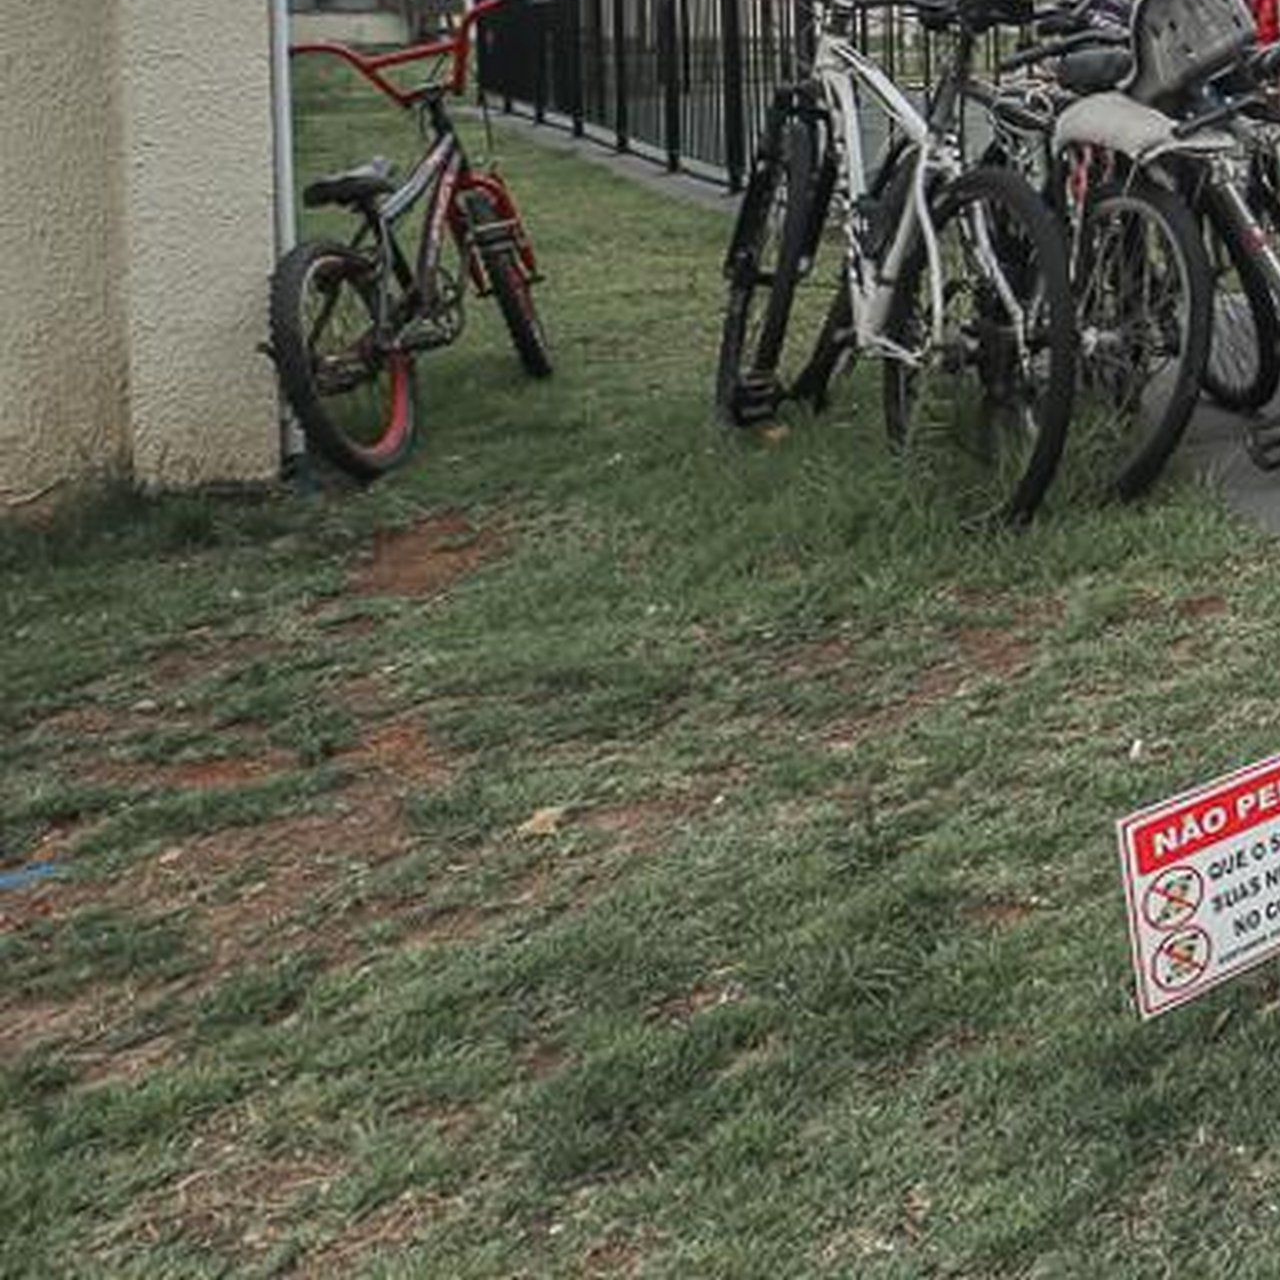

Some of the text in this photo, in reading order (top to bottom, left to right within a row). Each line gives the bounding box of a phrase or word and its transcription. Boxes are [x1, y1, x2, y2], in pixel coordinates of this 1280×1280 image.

[1154, 807, 1226, 857] NÃO
[1208, 851, 1248, 879] QUE
[1251, 841, 1267, 861] O
[1211, 875, 1261, 912] SUAS
[1234, 910, 1261, 937] NO
